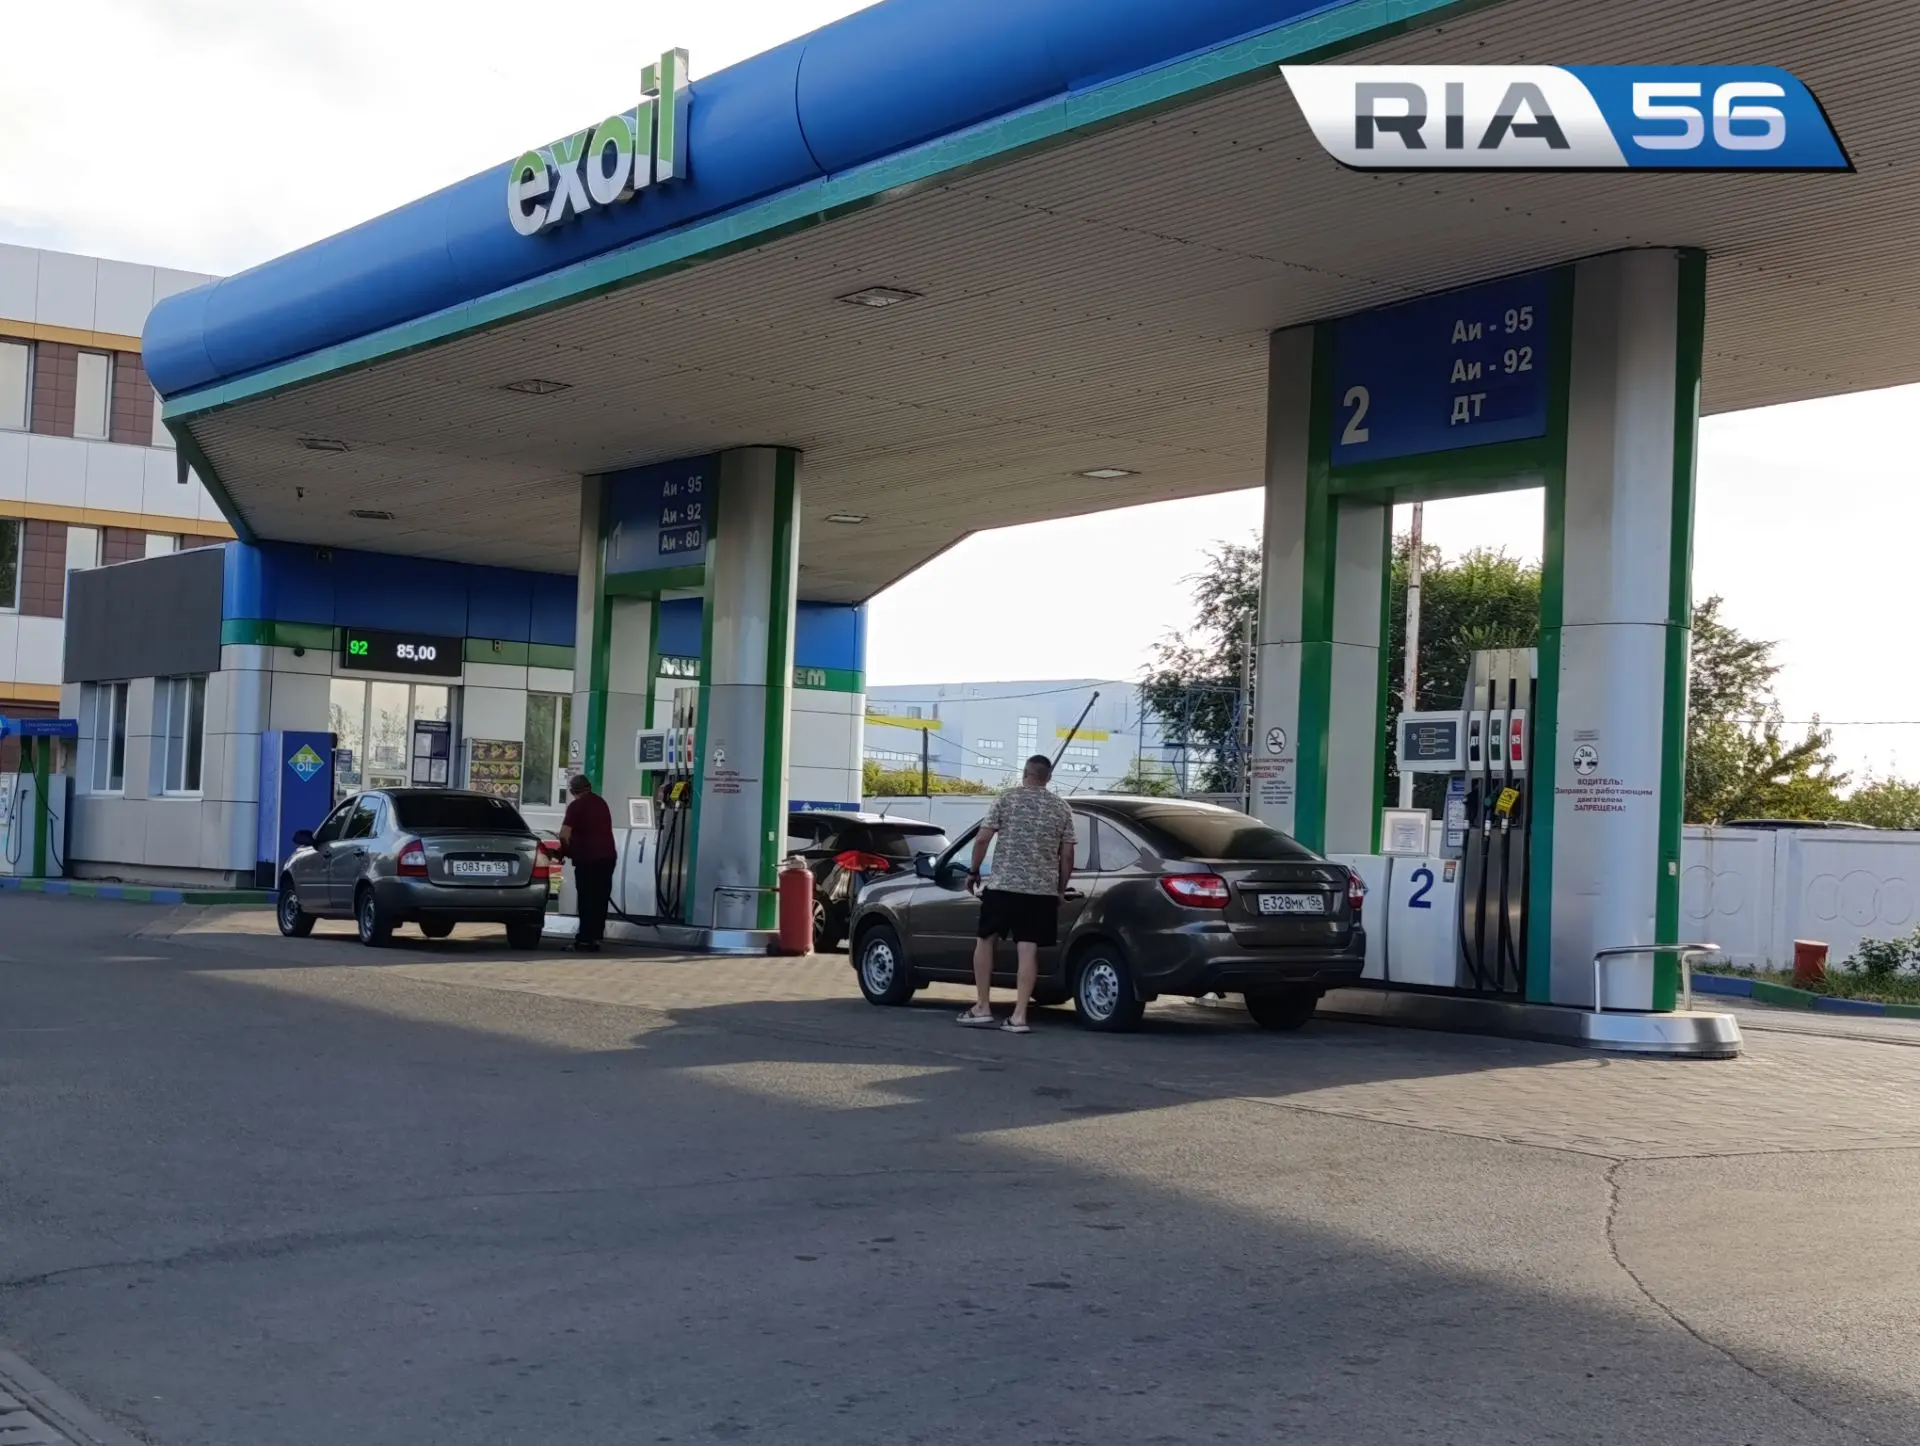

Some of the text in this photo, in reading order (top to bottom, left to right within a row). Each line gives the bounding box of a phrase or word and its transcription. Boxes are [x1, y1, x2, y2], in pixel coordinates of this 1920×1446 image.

[508, 48, 688, 236] exoil
[1451, 319, 1482, 344] Аи
[1504, 306, 1533, 333] 95
[1450, 358, 1482, 383] Аи
[1503, 346, 1533, 373] 92
[1341, 385, 1370, 446] 2
[1450, 392, 1487, 425] ДТ
[662, 480, 678, 498] Аи
[687, 475, 702, 493] 95
[662, 507, 677, 524] Аи
[686, 503, 701, 521] 92
[661, 534, 676, 551] Аи
[685, 530, 700, 548] 80
[349, 640, 437, 661] 92 85,00
[1408, 868, 1435, 909] 2
